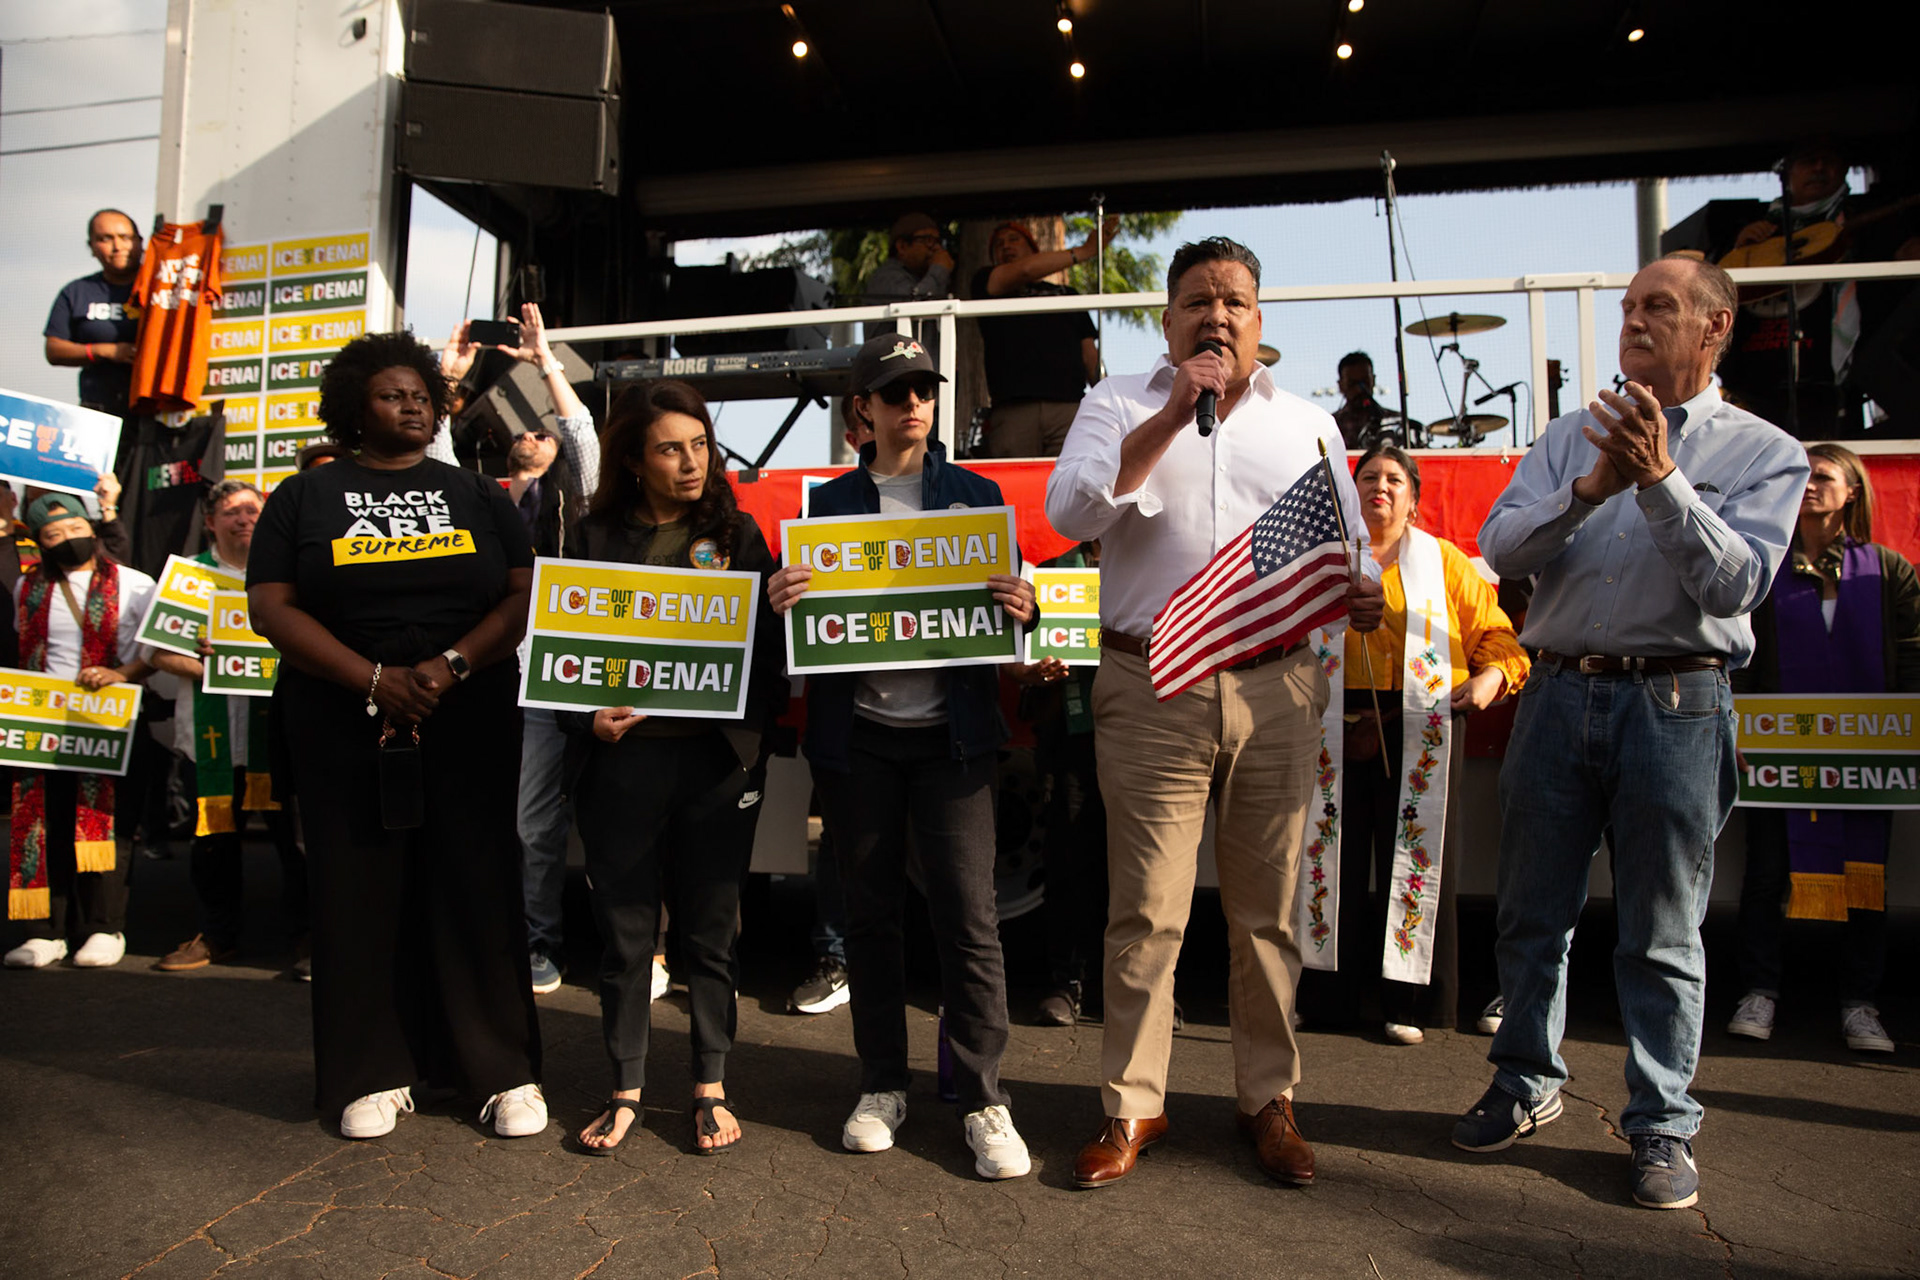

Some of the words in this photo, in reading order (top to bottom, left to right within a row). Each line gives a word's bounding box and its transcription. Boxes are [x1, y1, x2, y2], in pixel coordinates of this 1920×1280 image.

[275, 247, 304, 268] ICE
[314, 243, 366, 264] DENA!
[274, 285, 303, 305] ICE
[313, 279, 365, 301] DENA!
[86, 302, 124, 320] ICE
[210, 330, 260, 349] DENA!
[272, 324, 301, 344] ICE
[311, 320, 363, 341] DENA!
[208, 365, 260, 387] DENA!
[271, 362, 300, 381] ICE
[663, 357, 708, 376] KORG
[269, 401, 298, 421] ICE
[267, 439, 297, 459] ICE
[344, 490, 447, 508] BLACK
[347, 505, 451, 519] WOMEN
[343, 515, 455, 539] ARE
[348, 533, 465, 556] SUPREME
[864, 540, 887, 556] OUT
[887, 533, 998, 570] DENA!
[800, 541, 864, 573] ICE
[868, 556, 884, 571] OF
[170, 572, 216, 600] ICE
[610, 588, 634, 604] OUT
[1040, 584, 1086, 603] ICE
[548, 583, 611, 617] ICE
[613, 603, 629, 619] OF
[633, 590, 741, 625] DENA!
[154, 611, 199, 640] ICE
[805, 612, 870, 646] ICE
[869, 611, 892, 627] OUT
[893, 605, 1003, 641] DENA!
[873, 627, 889, 643] OF
[1040, 627, 1086, 648] ICE
[217, 655, 261, 678] ICE
[541, 652, 605, 685] ICE
[605, 657, 628, 673] OUT
[627, 659, 734, 693] DENA!
[607, 672, 623, 688] OF
[0, 684, 33, 706] CE
[47, 690, 128, 718] DENA!
[1744, 713, 1795, 736] ICE
[1796, 713, 1815, 724] OUT
[1816, 713, 1912, 737] DENA!
[1799, 724, 1812, 736] OF
[40, 732, 121, 759] DENA!
[1747, 765, 1799, 788] ICE
[1799, 766, 1818, 777] OUT
[1819, 766, 1917, 790] DENA!
[1802, 777, 1815, 789] OF
